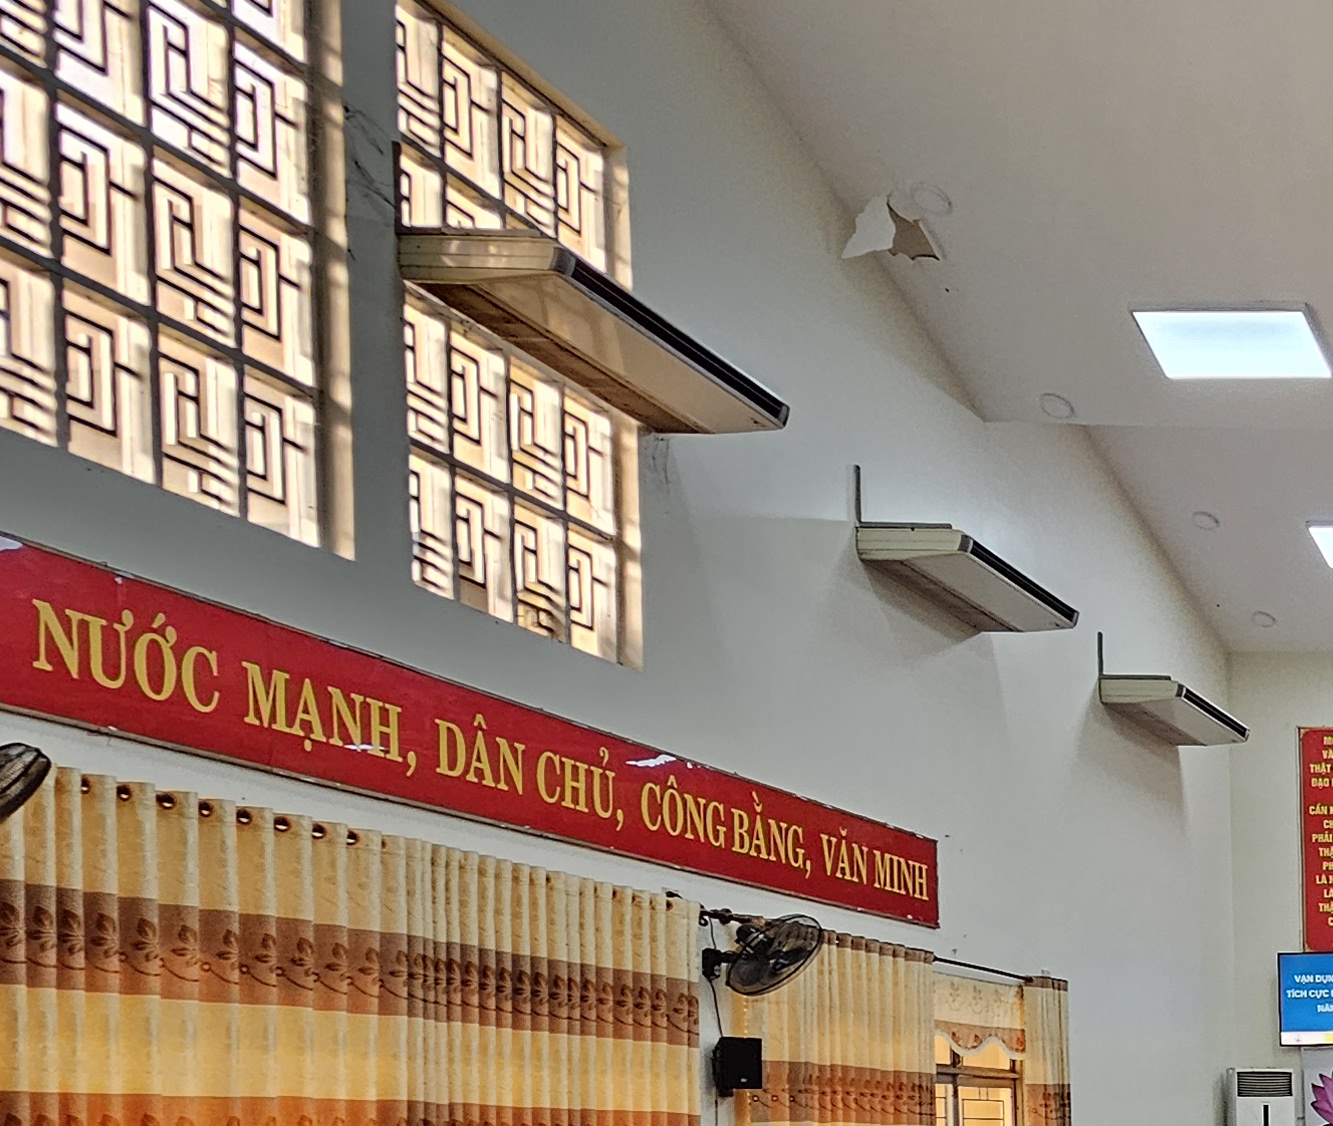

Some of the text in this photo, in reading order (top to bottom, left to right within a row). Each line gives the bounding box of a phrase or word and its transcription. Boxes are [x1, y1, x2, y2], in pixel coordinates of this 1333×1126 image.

[32, 599, 930, 900] NƯỚC MẠNH, DÂN CHỦ, CÔNG BẰNG, VĂN MINH
